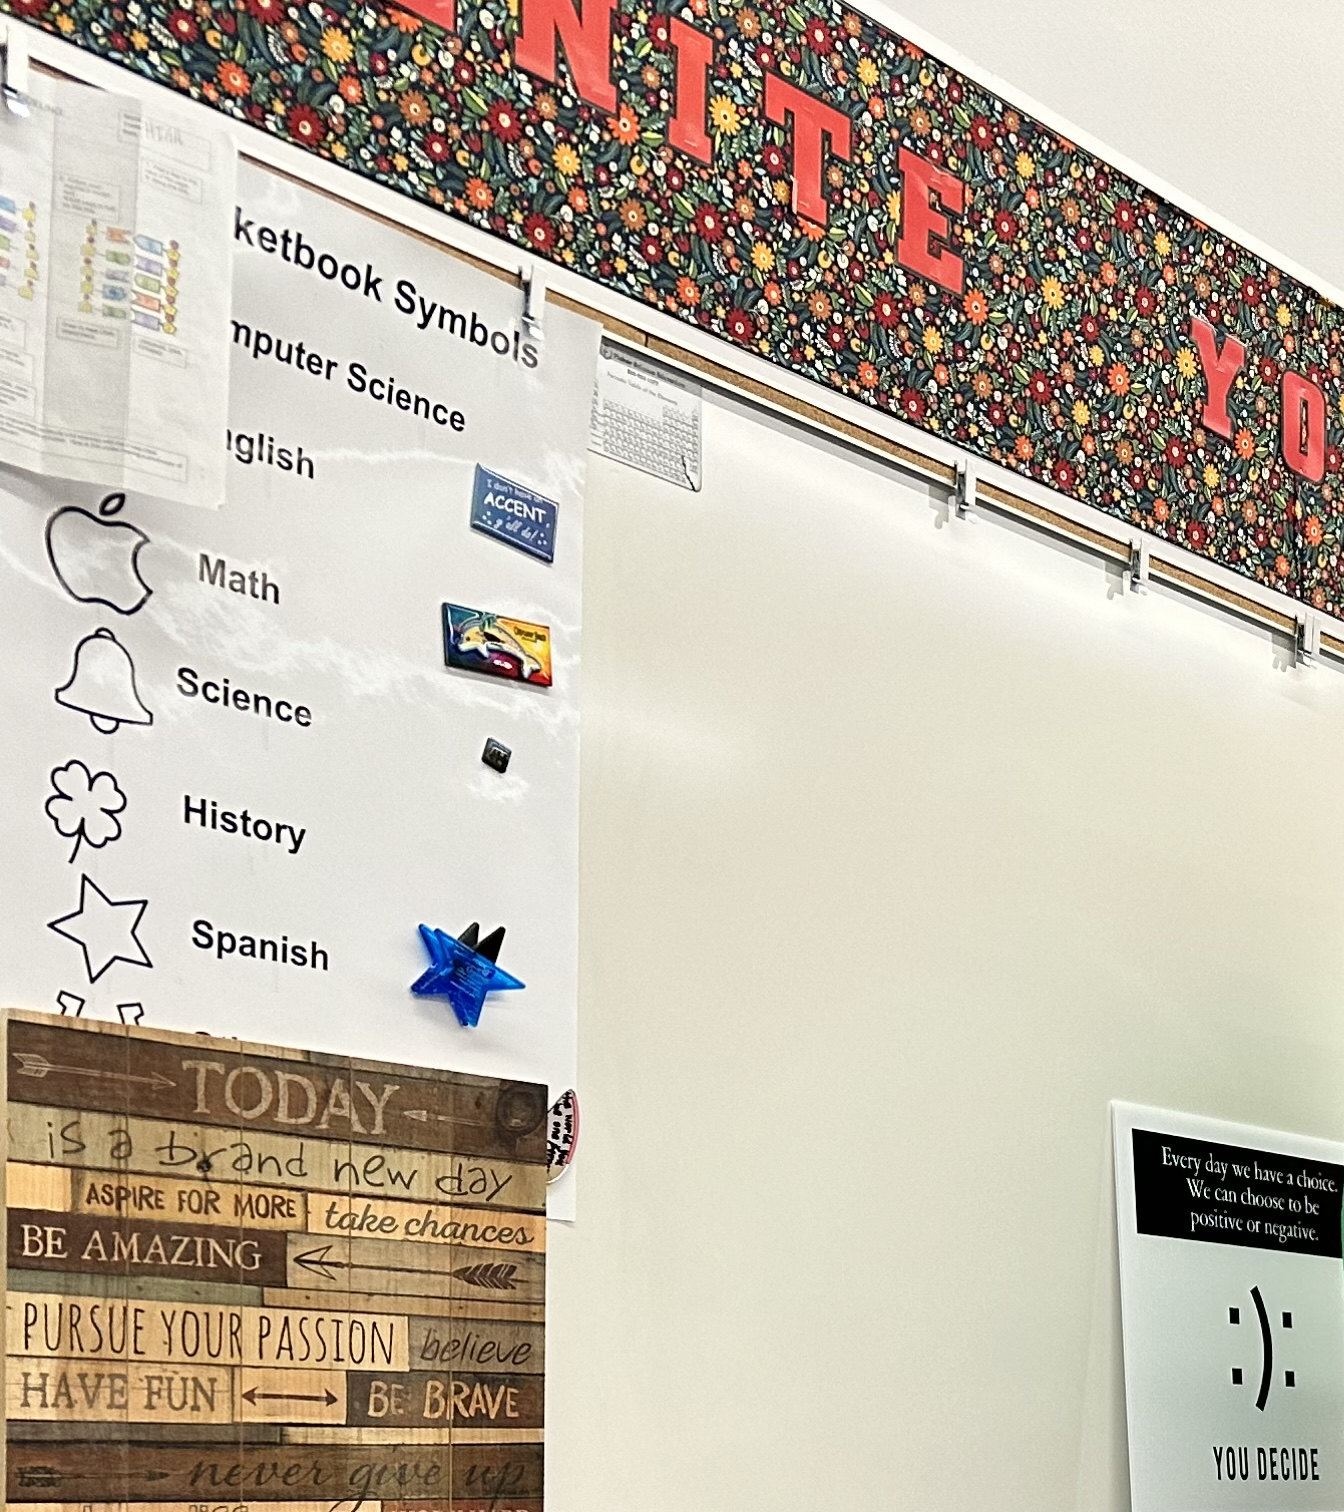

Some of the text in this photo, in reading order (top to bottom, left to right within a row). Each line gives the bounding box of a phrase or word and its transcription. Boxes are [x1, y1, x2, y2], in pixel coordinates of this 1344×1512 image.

[404, 0, 966, 296] NITE
[233, 205, 384, 303] ketbook
[393, 280, 539, 369] Symbols
[347, 362, 466, 432] Science
[226, 428, 314, 479] glish
[199, 553, 281, 605] Math
[176, 666, 313, 727] Science
[182, 794, 307, 855] History
[191, 919, 330, 972] Spanish
[182, 1060, 400, 1135] TODAY
[47, 1121, 513, 1201] is a brand new day
[1161, 1146, 1338, 1192] Every day we have a choice.
[86, 1183, 296, 1219] ASPIRE FOR MORE
[1186, 1178, 1320, 1215] We can choose to be
[21, 1224, 262, 1270] BE AMAZING
[324, 1201, 535, 1245] take chances
[1191, 1209, 1319, 1243] positive or negative.
[24, 1302, 393, 1365] PURSUE YOUR PASSION
[420, 1327, 532, 1365] believe
[20, 1371, 217, 1412] HAVE FUN
[367, 1380, 520, 1420] BE BRAVE
[187, 1457, 334, 1487] never
[464, 1460, 526, 1512] up
[1213, 1446, 1319, 1481] YOU DECIDE
